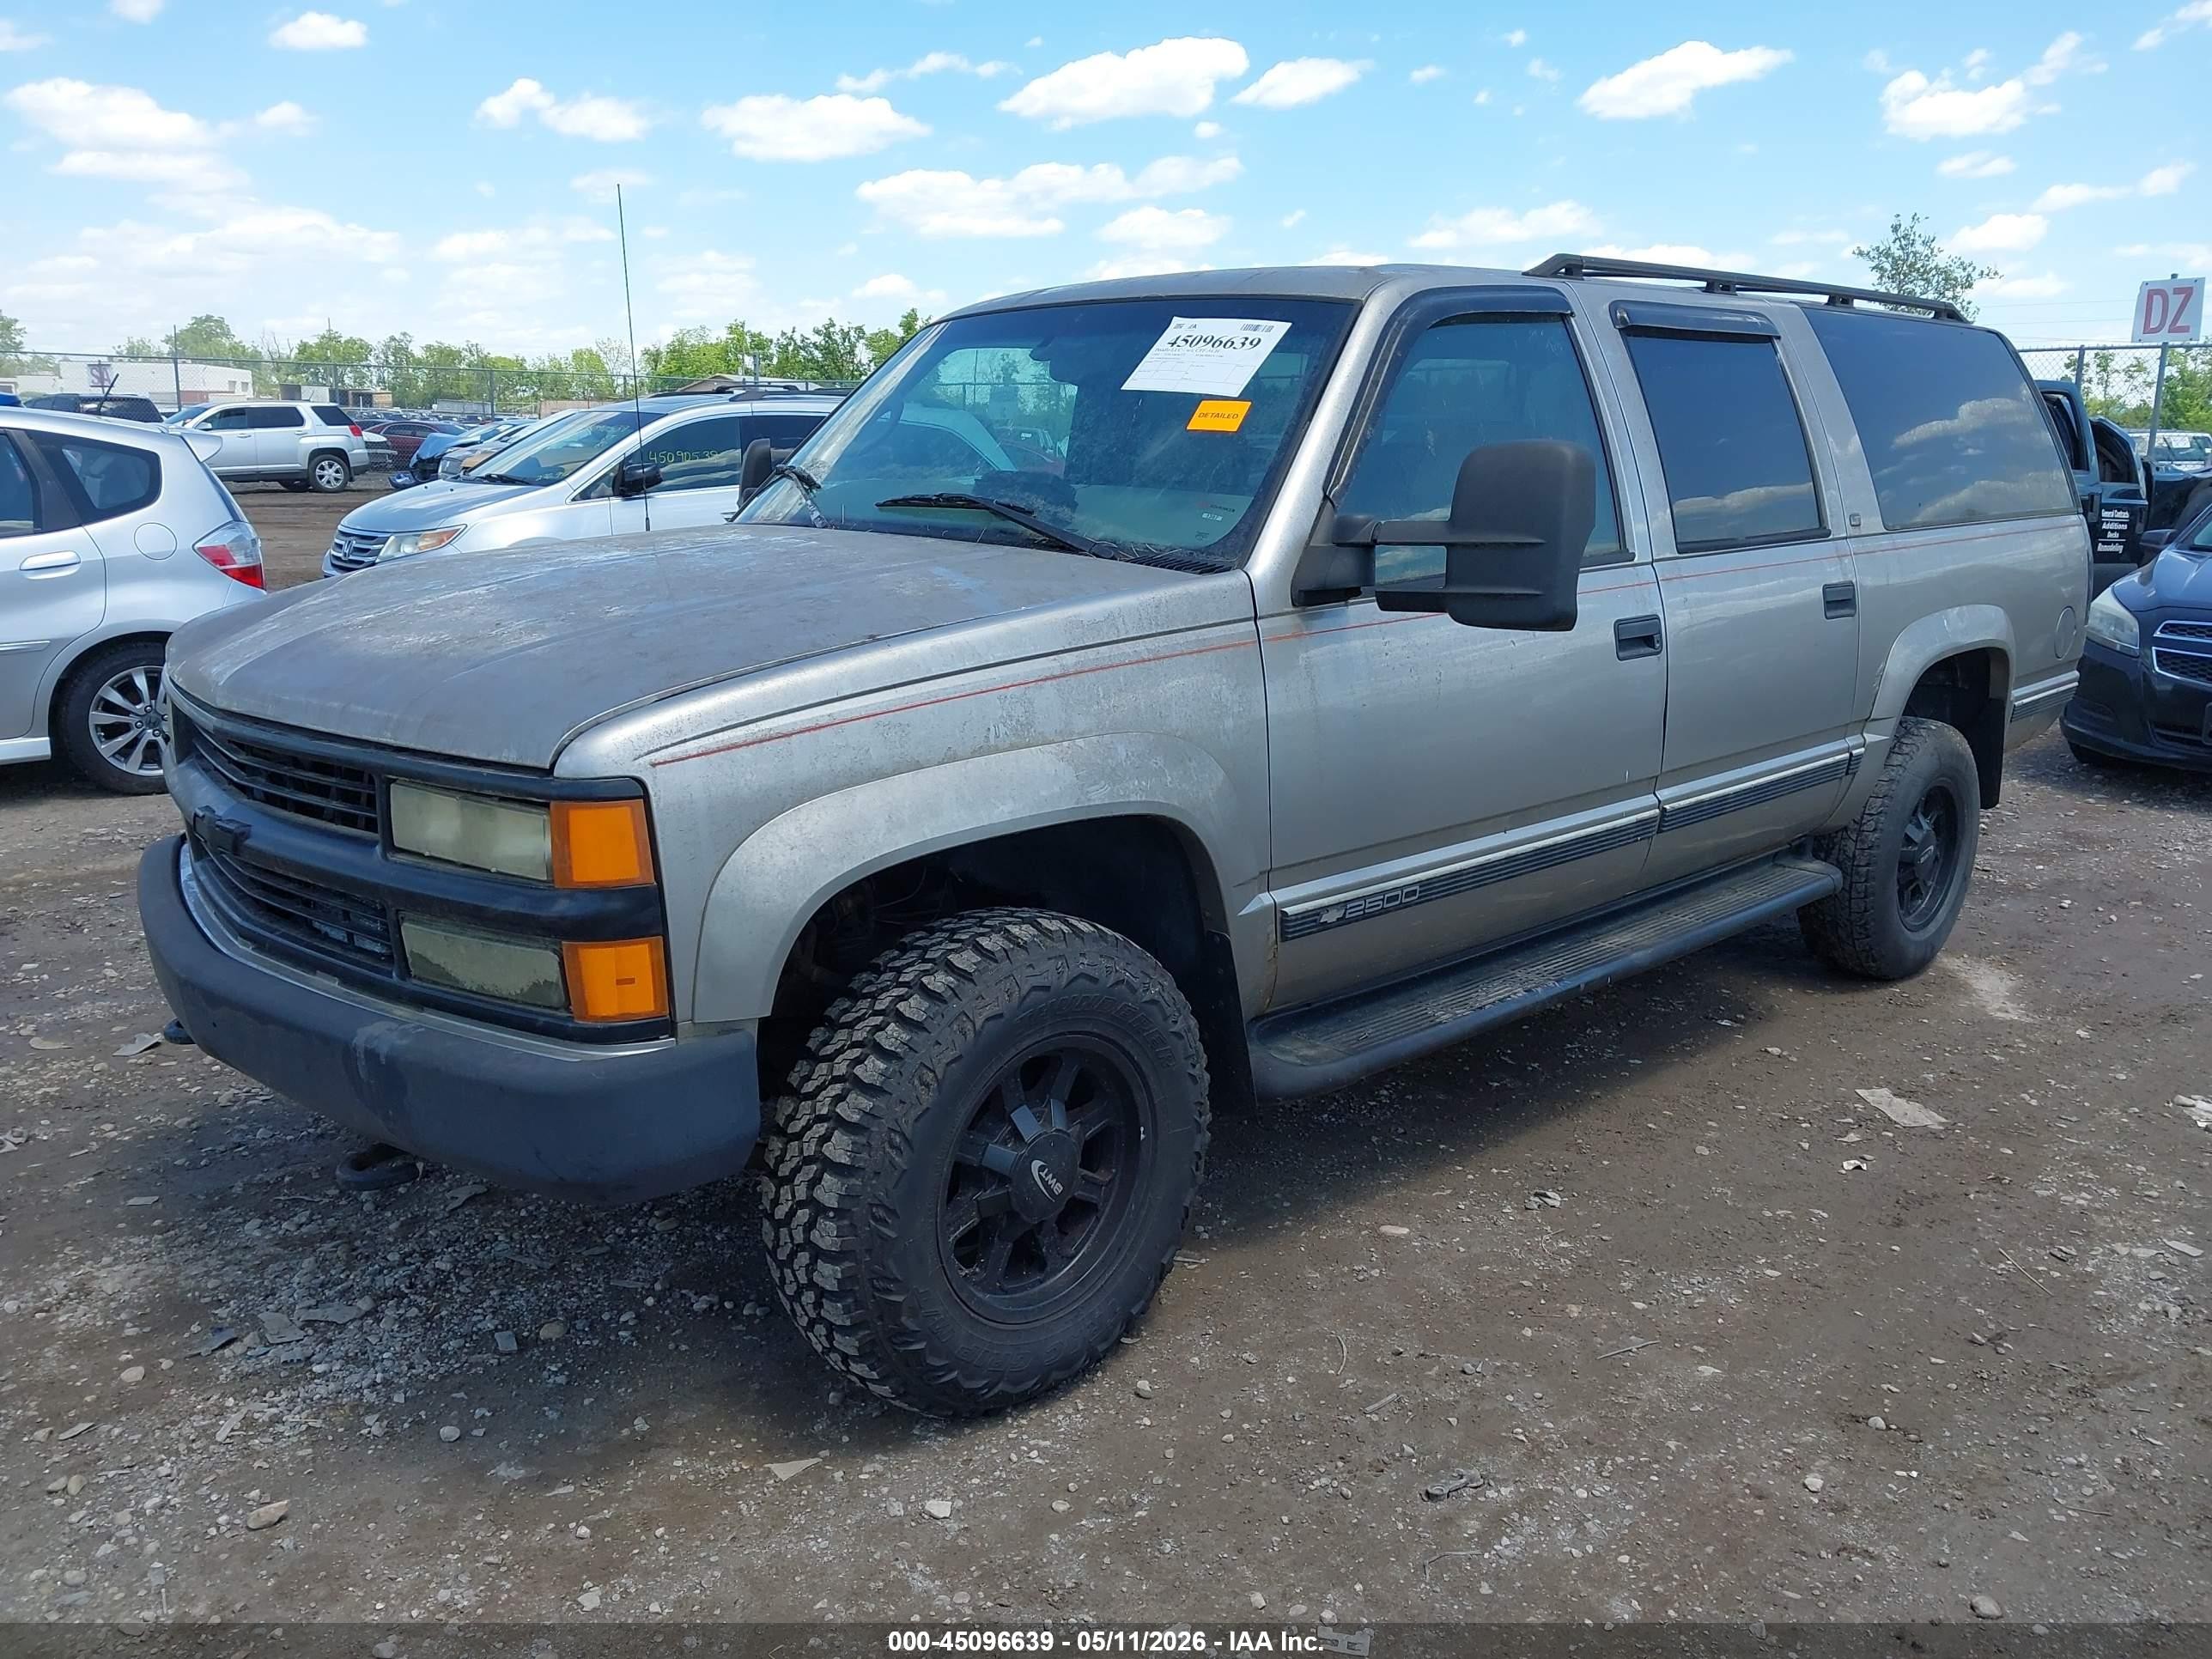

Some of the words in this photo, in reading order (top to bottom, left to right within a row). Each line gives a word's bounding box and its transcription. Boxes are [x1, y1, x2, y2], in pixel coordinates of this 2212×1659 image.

[2142, 286, 2194, 335] DZ
[1167, 334, 1262, 351] 45096639
[2101, 521, 2128, 530] Additions
[2097, 543, 2124, 554] Remodeling
[1345, 885, 1420, 919] 2500
